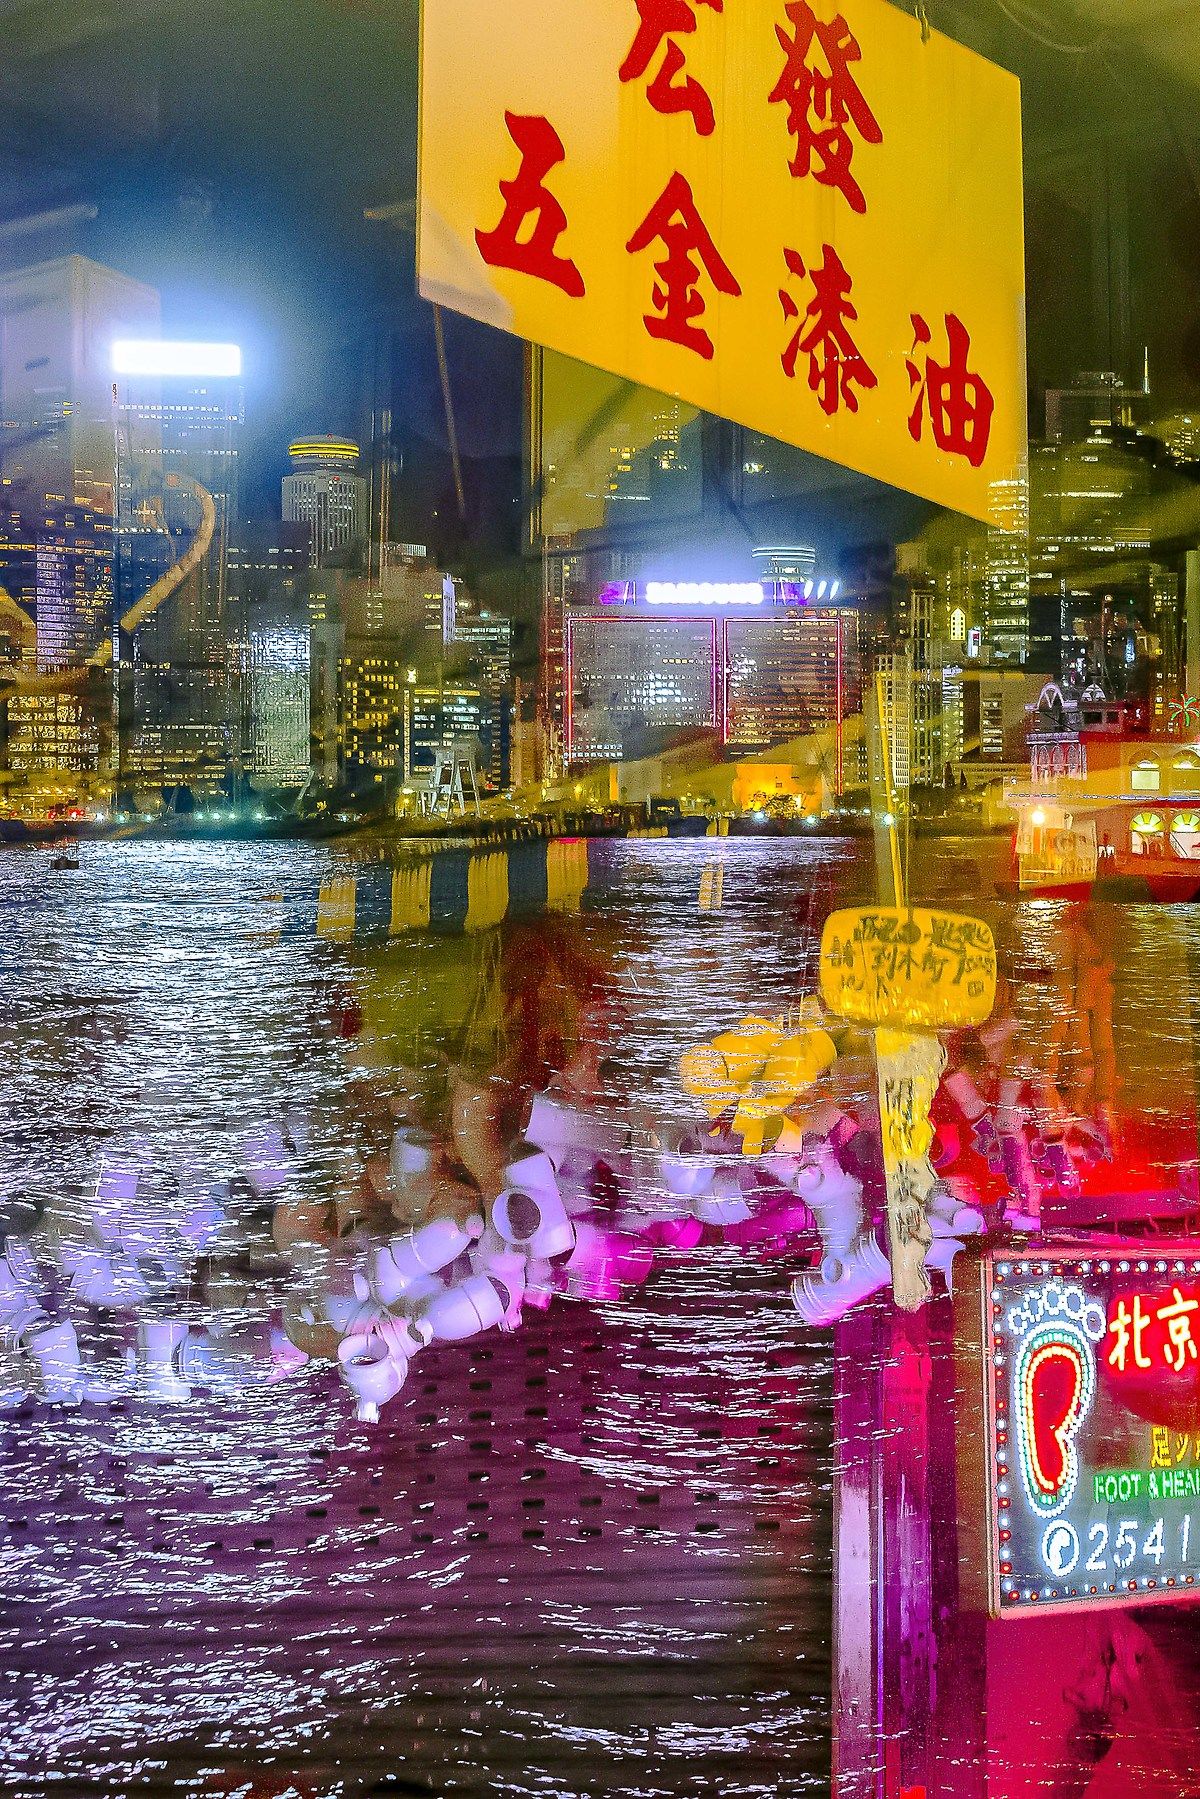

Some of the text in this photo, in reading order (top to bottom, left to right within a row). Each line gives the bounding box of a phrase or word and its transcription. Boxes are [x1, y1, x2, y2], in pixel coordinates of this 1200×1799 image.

[474, 109, 995, 468] 五金漆油
[1094, 1471, 1141, 1504] FOOT
[1149, 1469, 1160, 1500] &
[1085, 1514, 1192, 1573] 2541
